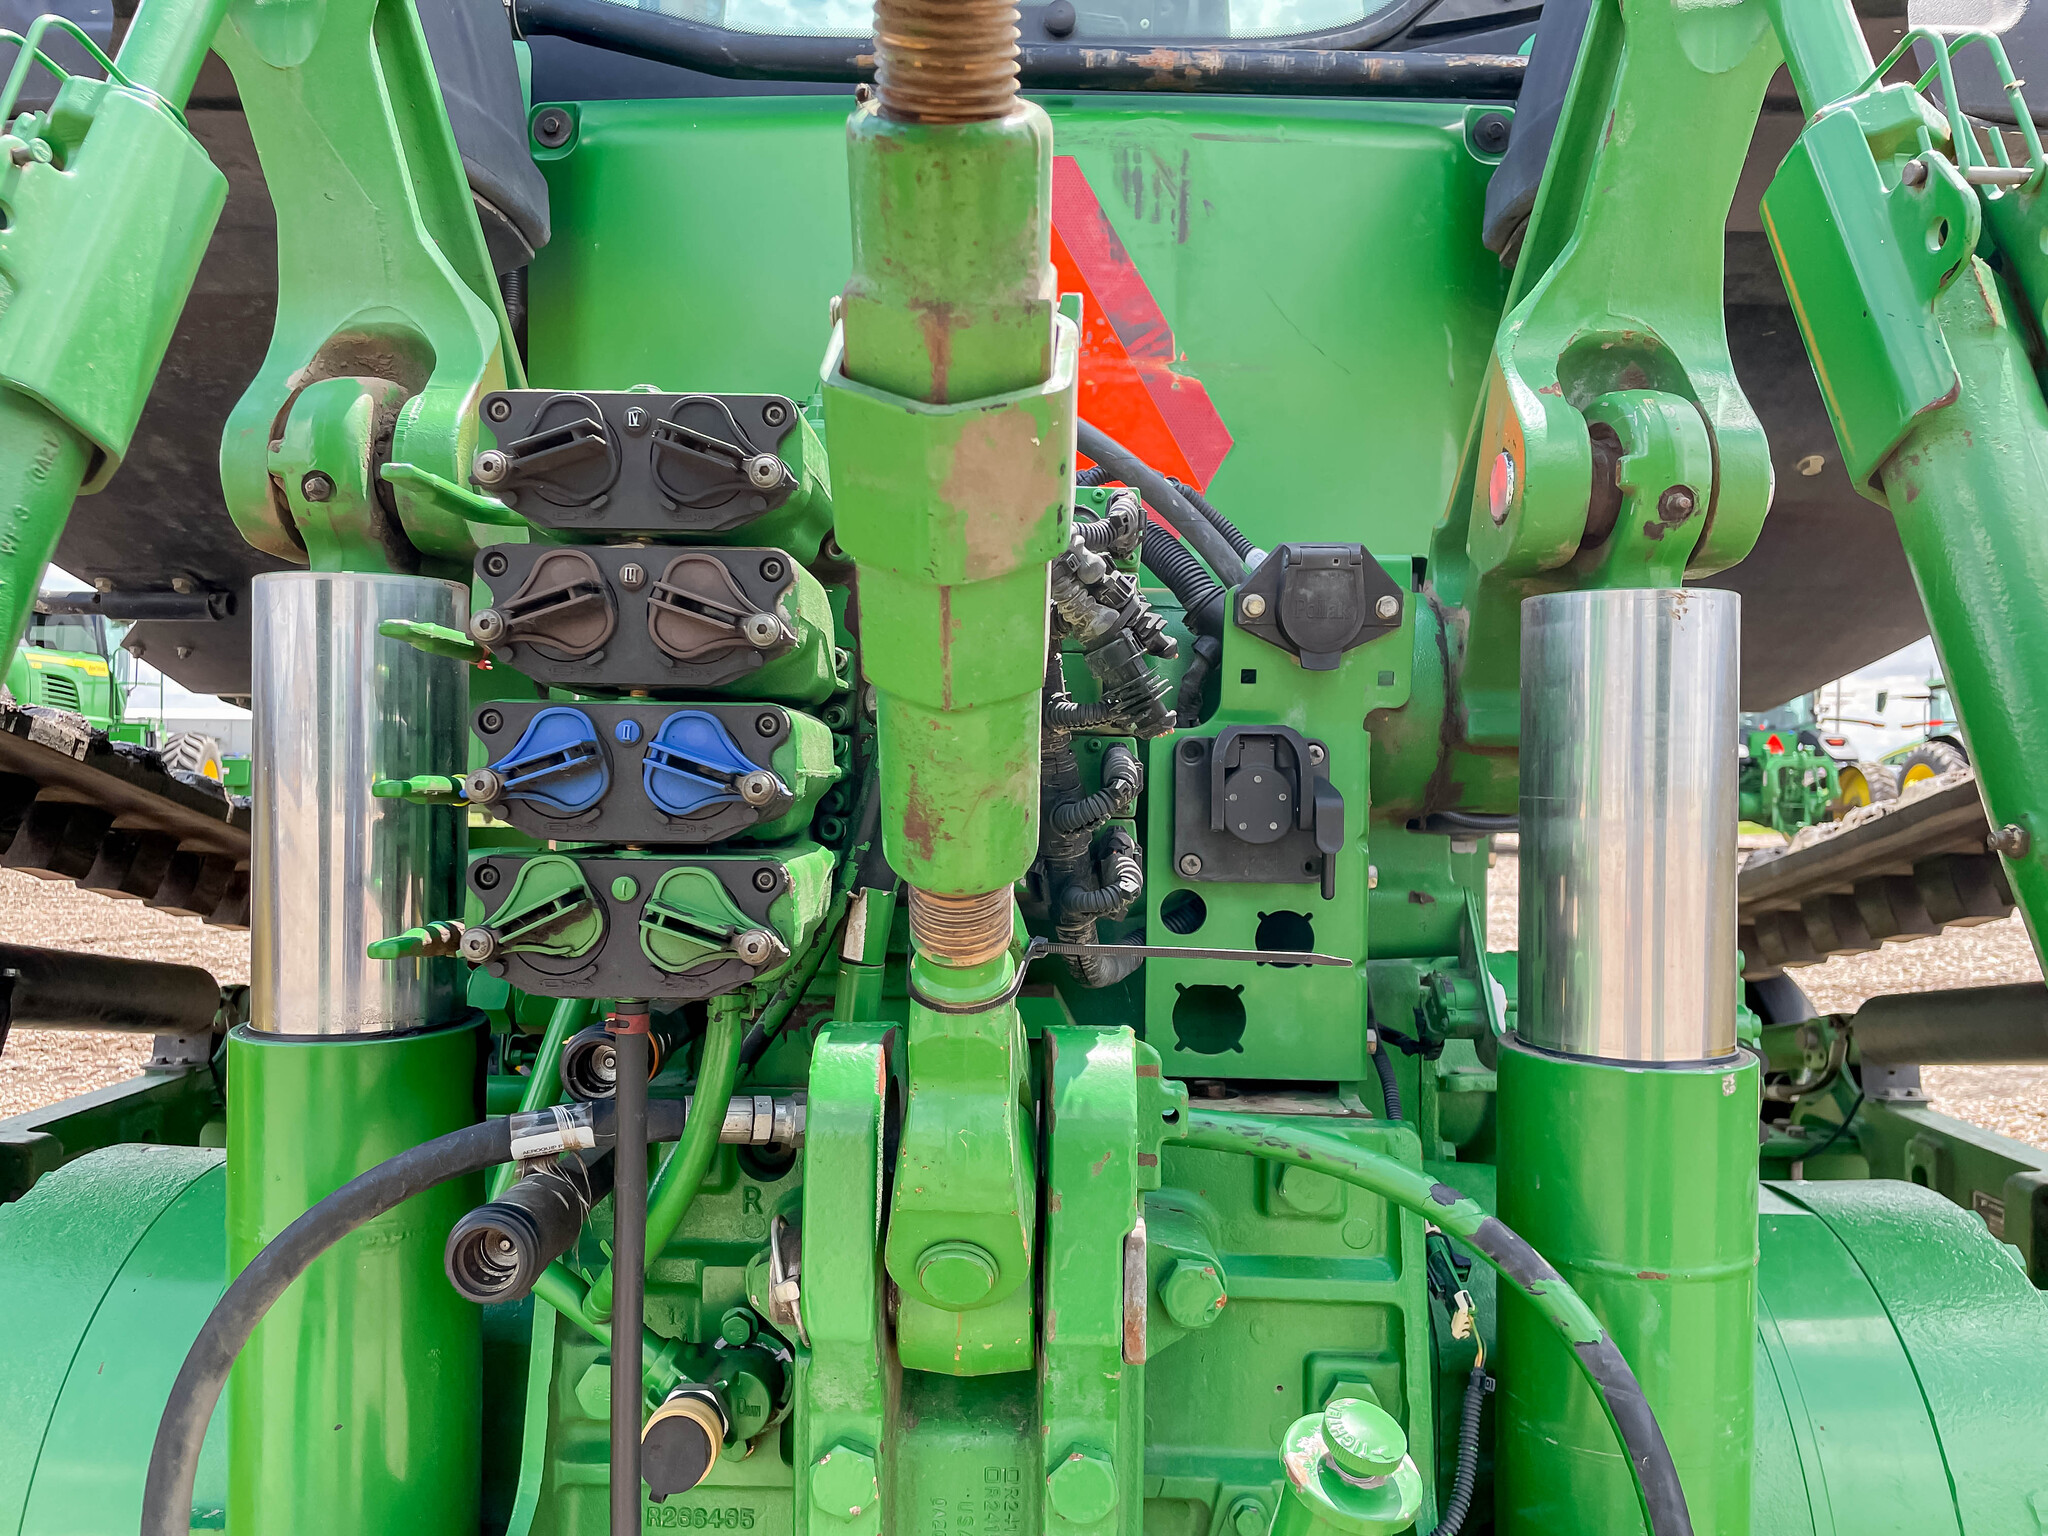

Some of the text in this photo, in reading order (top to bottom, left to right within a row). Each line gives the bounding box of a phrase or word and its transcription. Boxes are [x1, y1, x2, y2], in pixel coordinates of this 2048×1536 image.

[627, 410, 642, 427] IV
[623, 567, 639, 584] III
[1295, 599, 1354, 620] Pollak
[621, 724, 632, 741] II
[743, 1186, 764, 1215] R
[1325, 1398, 1369, 1460] TIGHTEN
